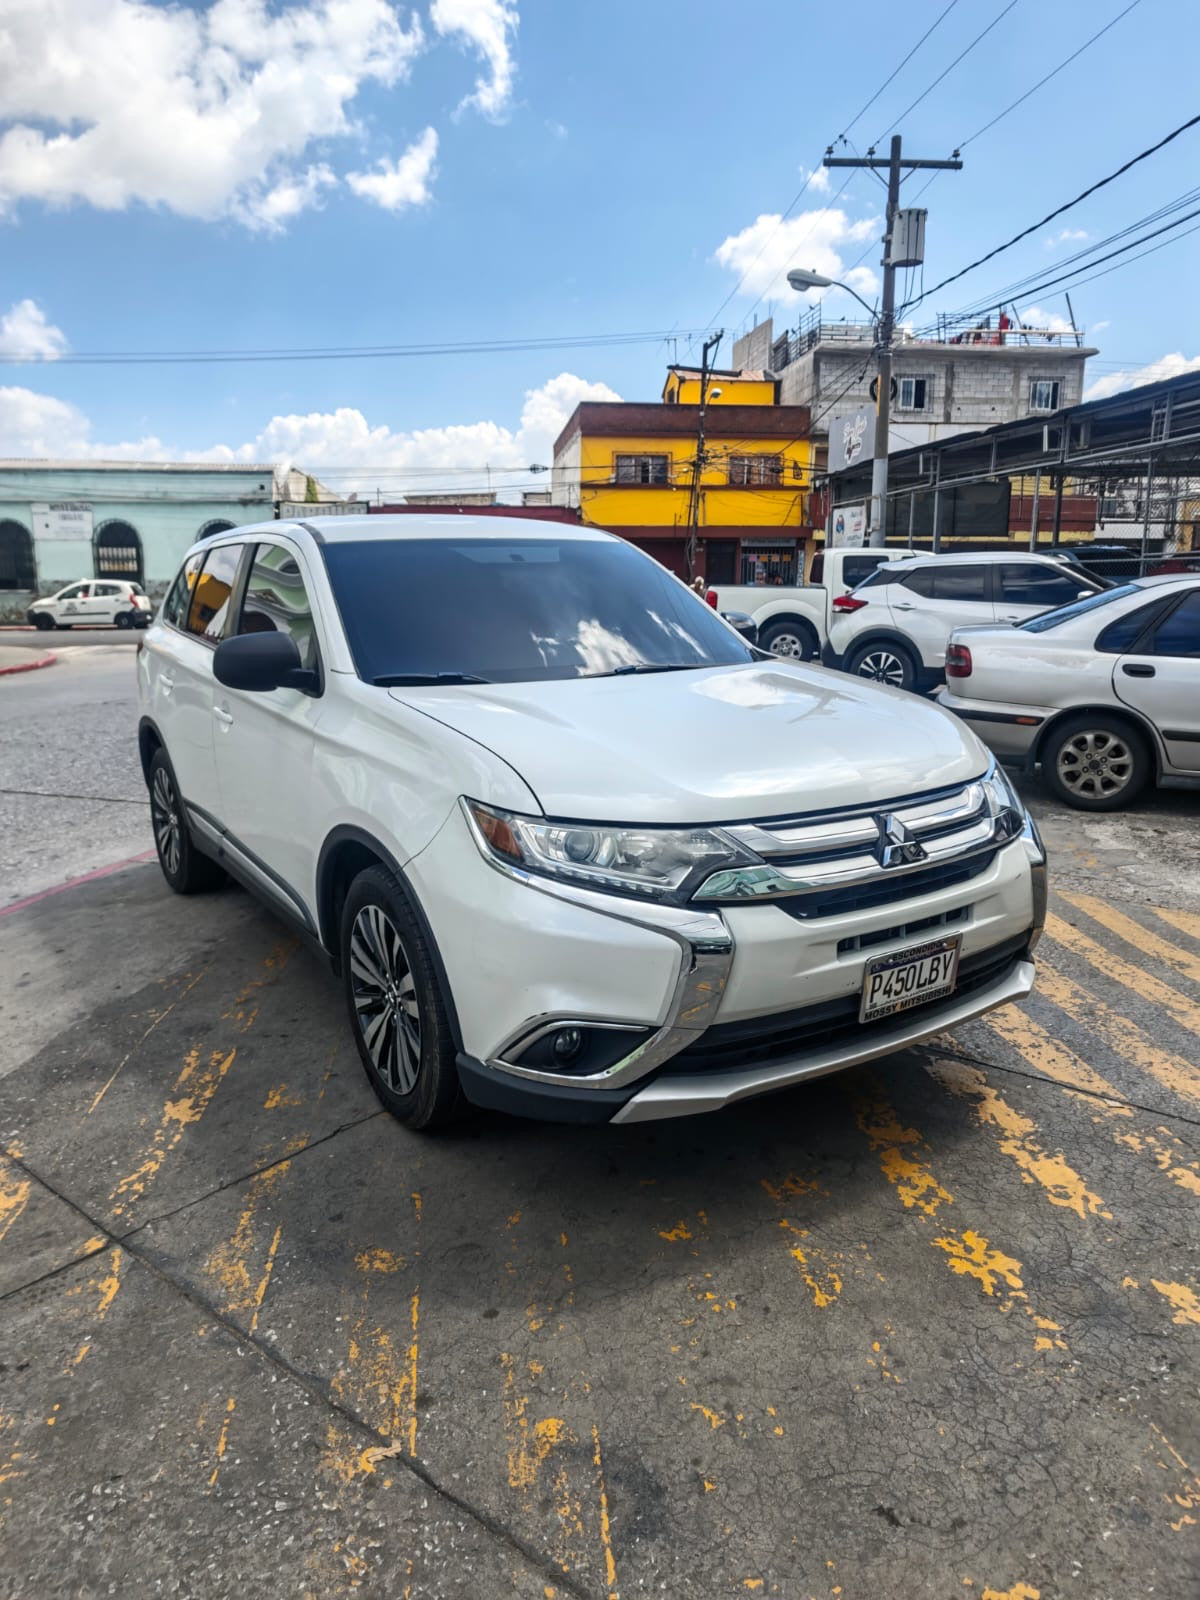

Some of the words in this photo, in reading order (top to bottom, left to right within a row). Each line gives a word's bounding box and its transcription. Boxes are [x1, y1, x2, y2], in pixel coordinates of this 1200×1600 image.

[869, 951, 954, 1004] P450LBY
[864, 1003, 898, 1021] MOSSY
[899, 985, 952, 1010] MITSUBISHI
